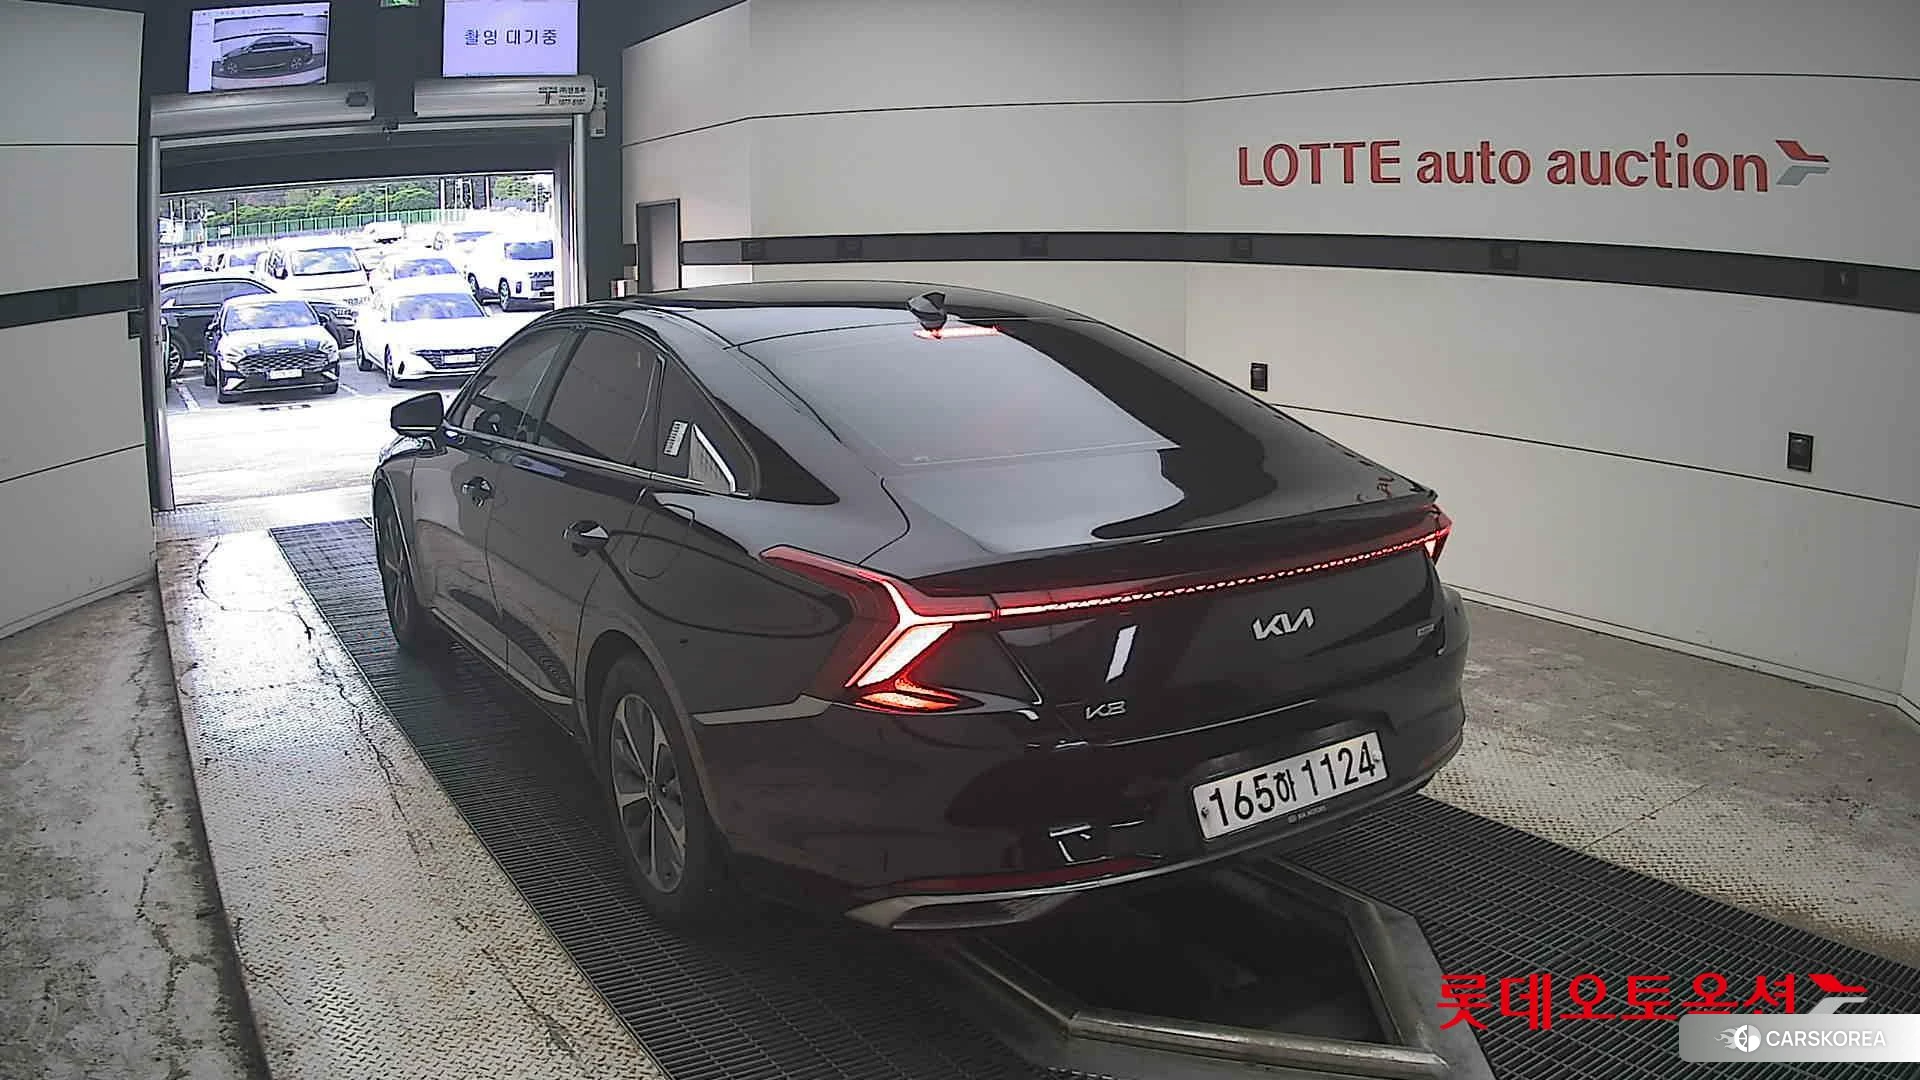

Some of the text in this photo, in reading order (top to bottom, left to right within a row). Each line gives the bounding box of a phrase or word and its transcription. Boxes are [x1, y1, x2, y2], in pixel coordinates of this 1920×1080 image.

[505, 29, 557, 46] 대기중
[1238, 133, 1769, 193] LOTTE auto auction
[1252, 608, 1314, 640] KIA
[1086, 700, 1126, 719] K8
[1209, 769, 1297, 827] 165하
[1301, 741, 1375, 796] 1124
